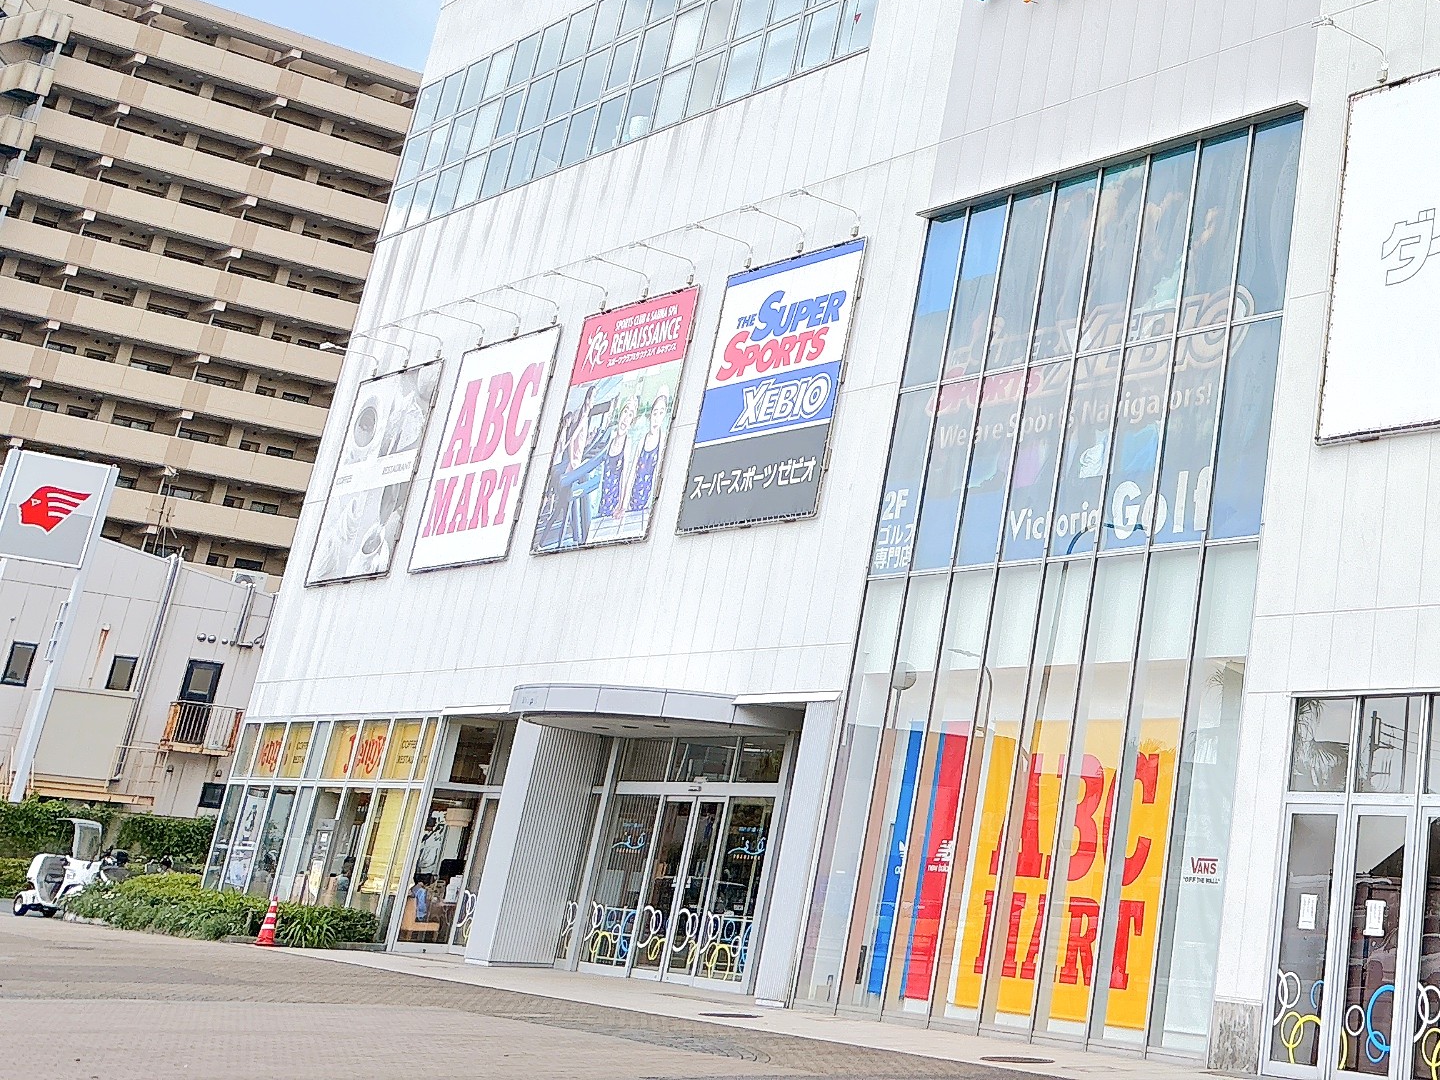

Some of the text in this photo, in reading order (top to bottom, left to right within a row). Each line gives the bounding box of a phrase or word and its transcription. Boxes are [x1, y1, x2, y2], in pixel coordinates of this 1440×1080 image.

[610, 316, 683, 355] RENAISSANCE
[615, 317, 633, 331] SPORTS
[736, 290, 847, 341] THE SUPER
[715, 326, 830, 381] SPORTS
[440, 362, 545, 469] ABC
[729, 373, 832, 433] XEBIO
[940, 426, 965, 448] We
[1081, 382, 1213, 425] Naigaors!
[422, 463, 521, 538] MART
[690, 456, 817, 500] スーパースポーツゼビオ
[882, 488, 909, 521] 2F
[1112, 467, 1211, 540] Golf
[989, 752, 1159, 887] ABC
[1191, 856, 1218, 874] VANS
